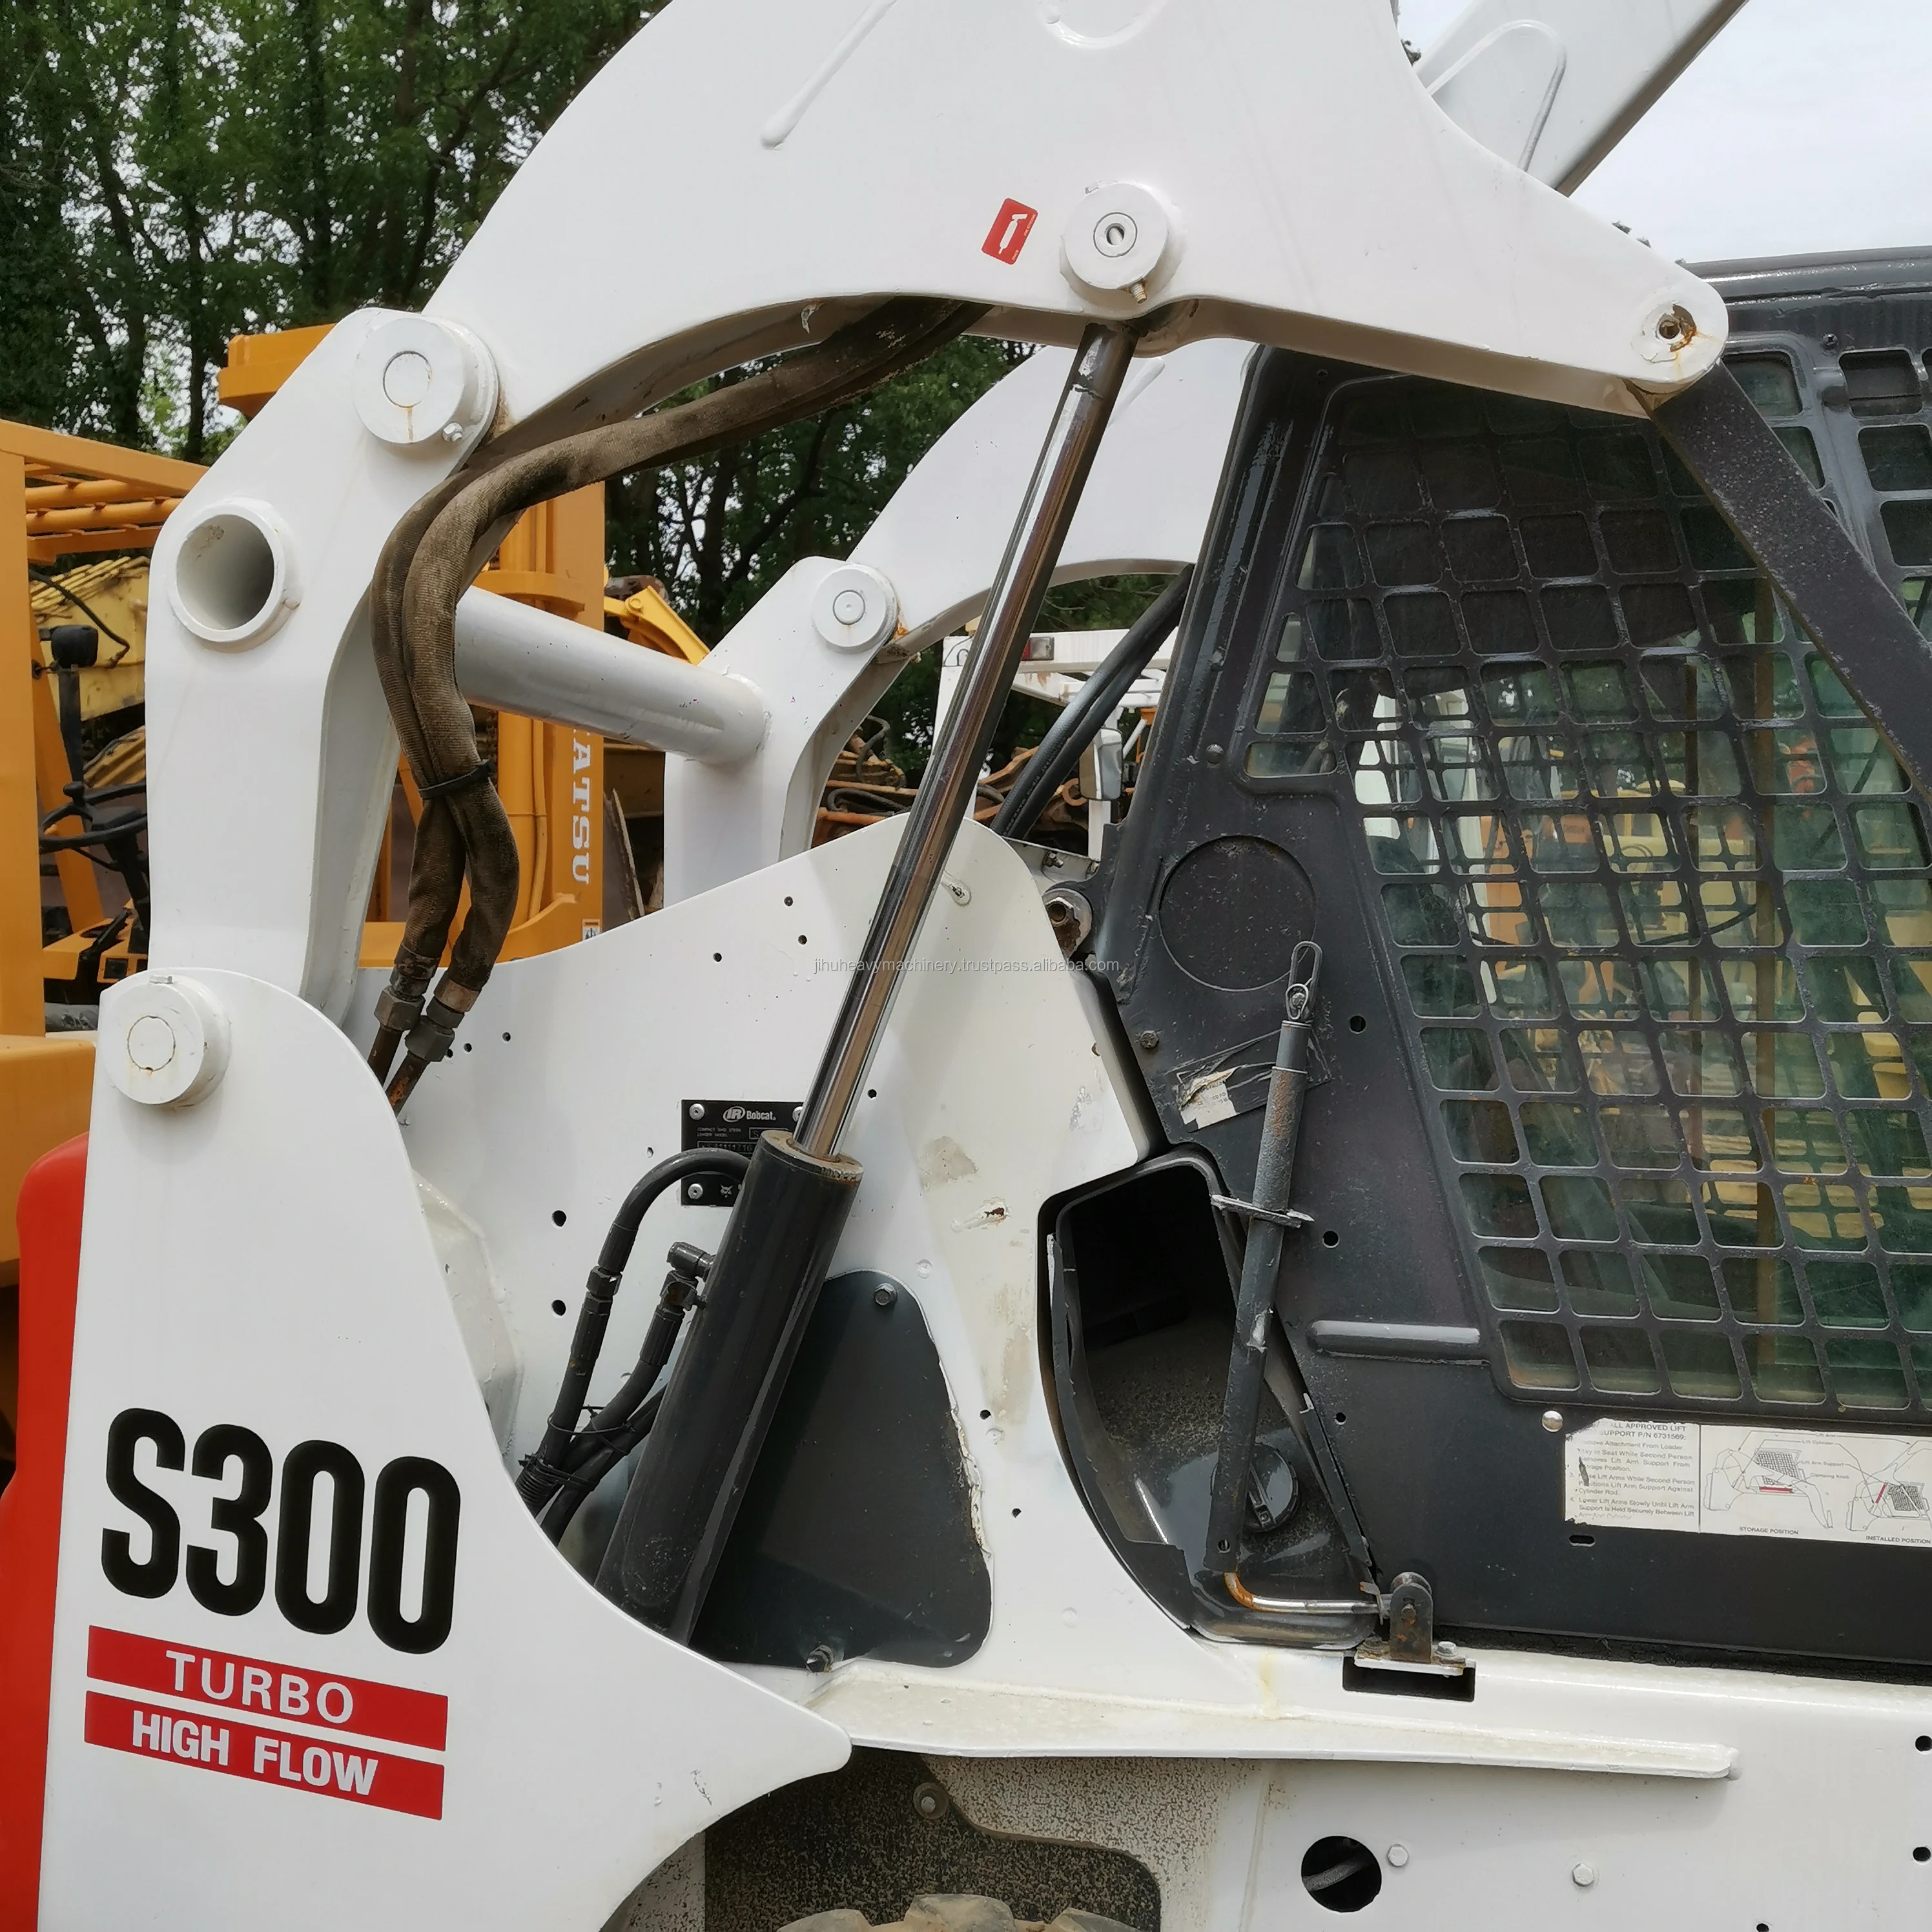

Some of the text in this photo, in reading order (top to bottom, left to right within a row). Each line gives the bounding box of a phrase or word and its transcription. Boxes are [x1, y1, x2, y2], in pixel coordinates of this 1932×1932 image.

[572, 729, 591, 885] ATSU
[1625, 1423, 1668, 1431] APPROVED
[101, 1407, 461, 1654] S300
[165, 1649, 353, 1723] TURBO
[132, 1710, 379, 1796] HIGH FLOW
